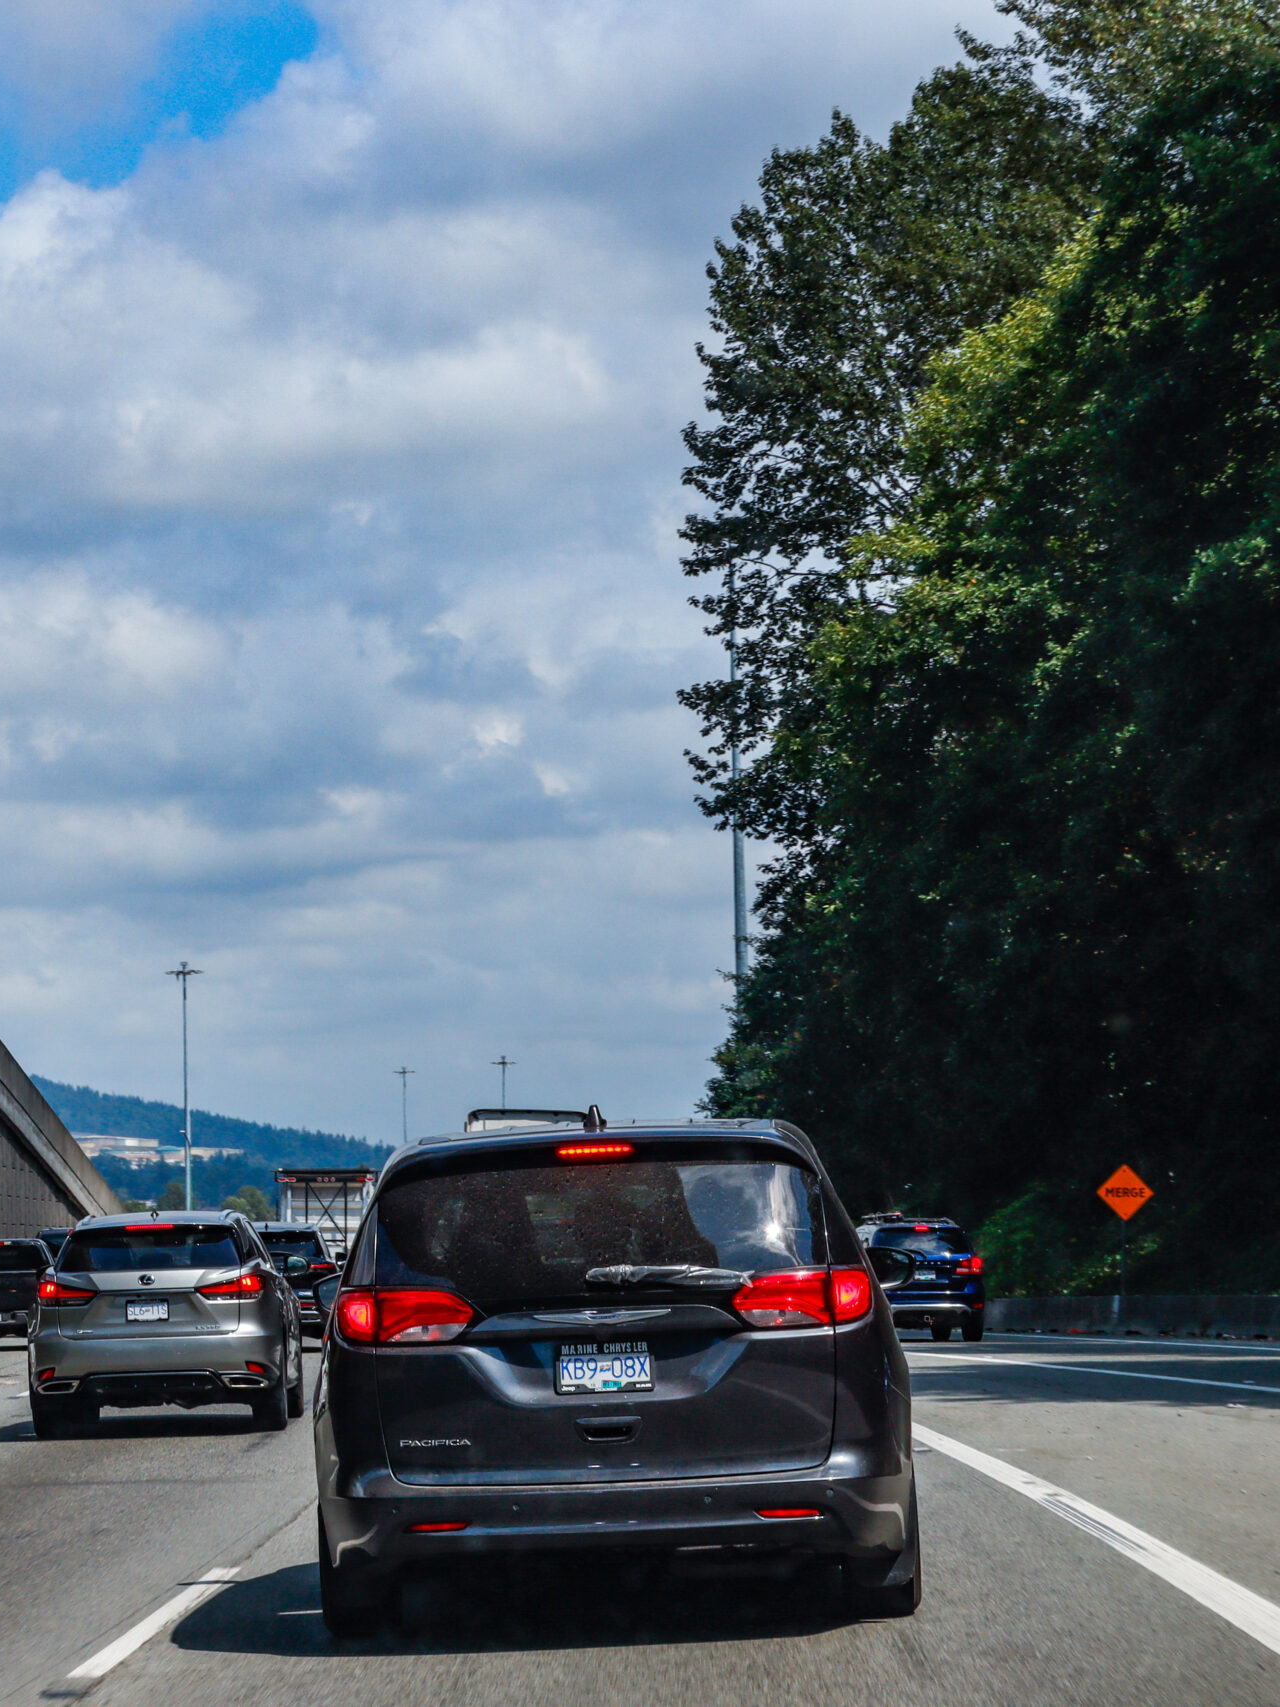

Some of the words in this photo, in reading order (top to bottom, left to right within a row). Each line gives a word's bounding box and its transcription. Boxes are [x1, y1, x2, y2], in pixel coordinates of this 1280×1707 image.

[1105, 1187, 1145, 1198] MERGE
[561, 1344, 598, 1354] MARINE
[603, 1341, 648, 1353] CHRYSLER
[400, 1438, 472, 1447] PACIFICA
